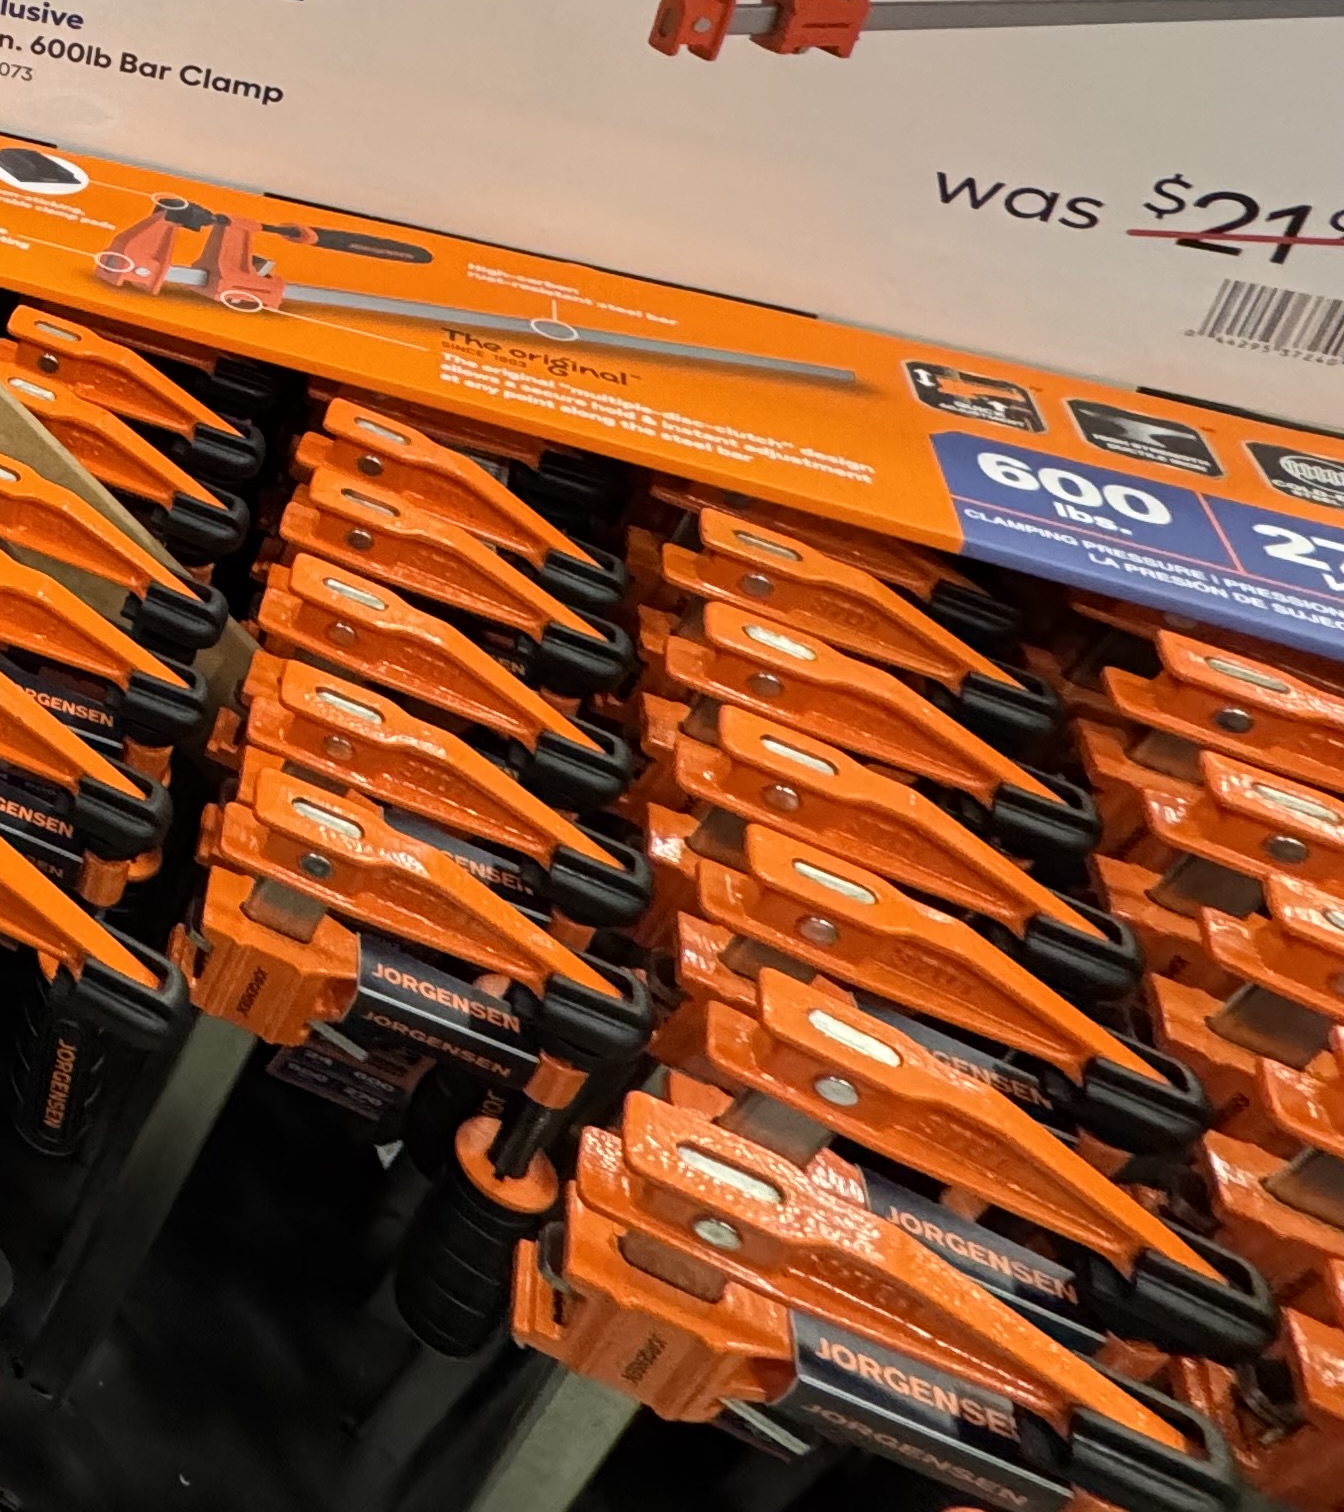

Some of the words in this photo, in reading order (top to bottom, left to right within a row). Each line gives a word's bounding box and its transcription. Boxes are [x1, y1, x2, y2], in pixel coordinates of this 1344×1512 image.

[29, 33, 112, 70] 600lb
[119, 51, 172, 83] Bar
[178, 61, 285, 105] Clamp
[935, 170, 1104, 231] was
[441, 351, 477, 369] The
[481, 361, 555, 390] original
[799, 445, 875, 476] design
[977, 451, 1172, 525] 600
[1053, 501, 1133, 536] lbs.
[963, 508, 1078, 547] CLAMPING
[1082, 534, 1206, 582] PRESSURE
[372, 961, 521, 1034] JORGENSEN
[363, 1009, 511, 1078] JORGENSEN
[44, 1037, 79, 1131] JORGENSEN
[885, 1204, 1079, 1306] JORGENSEN
[815, 1335, 1022, 1443] JORGENSE
